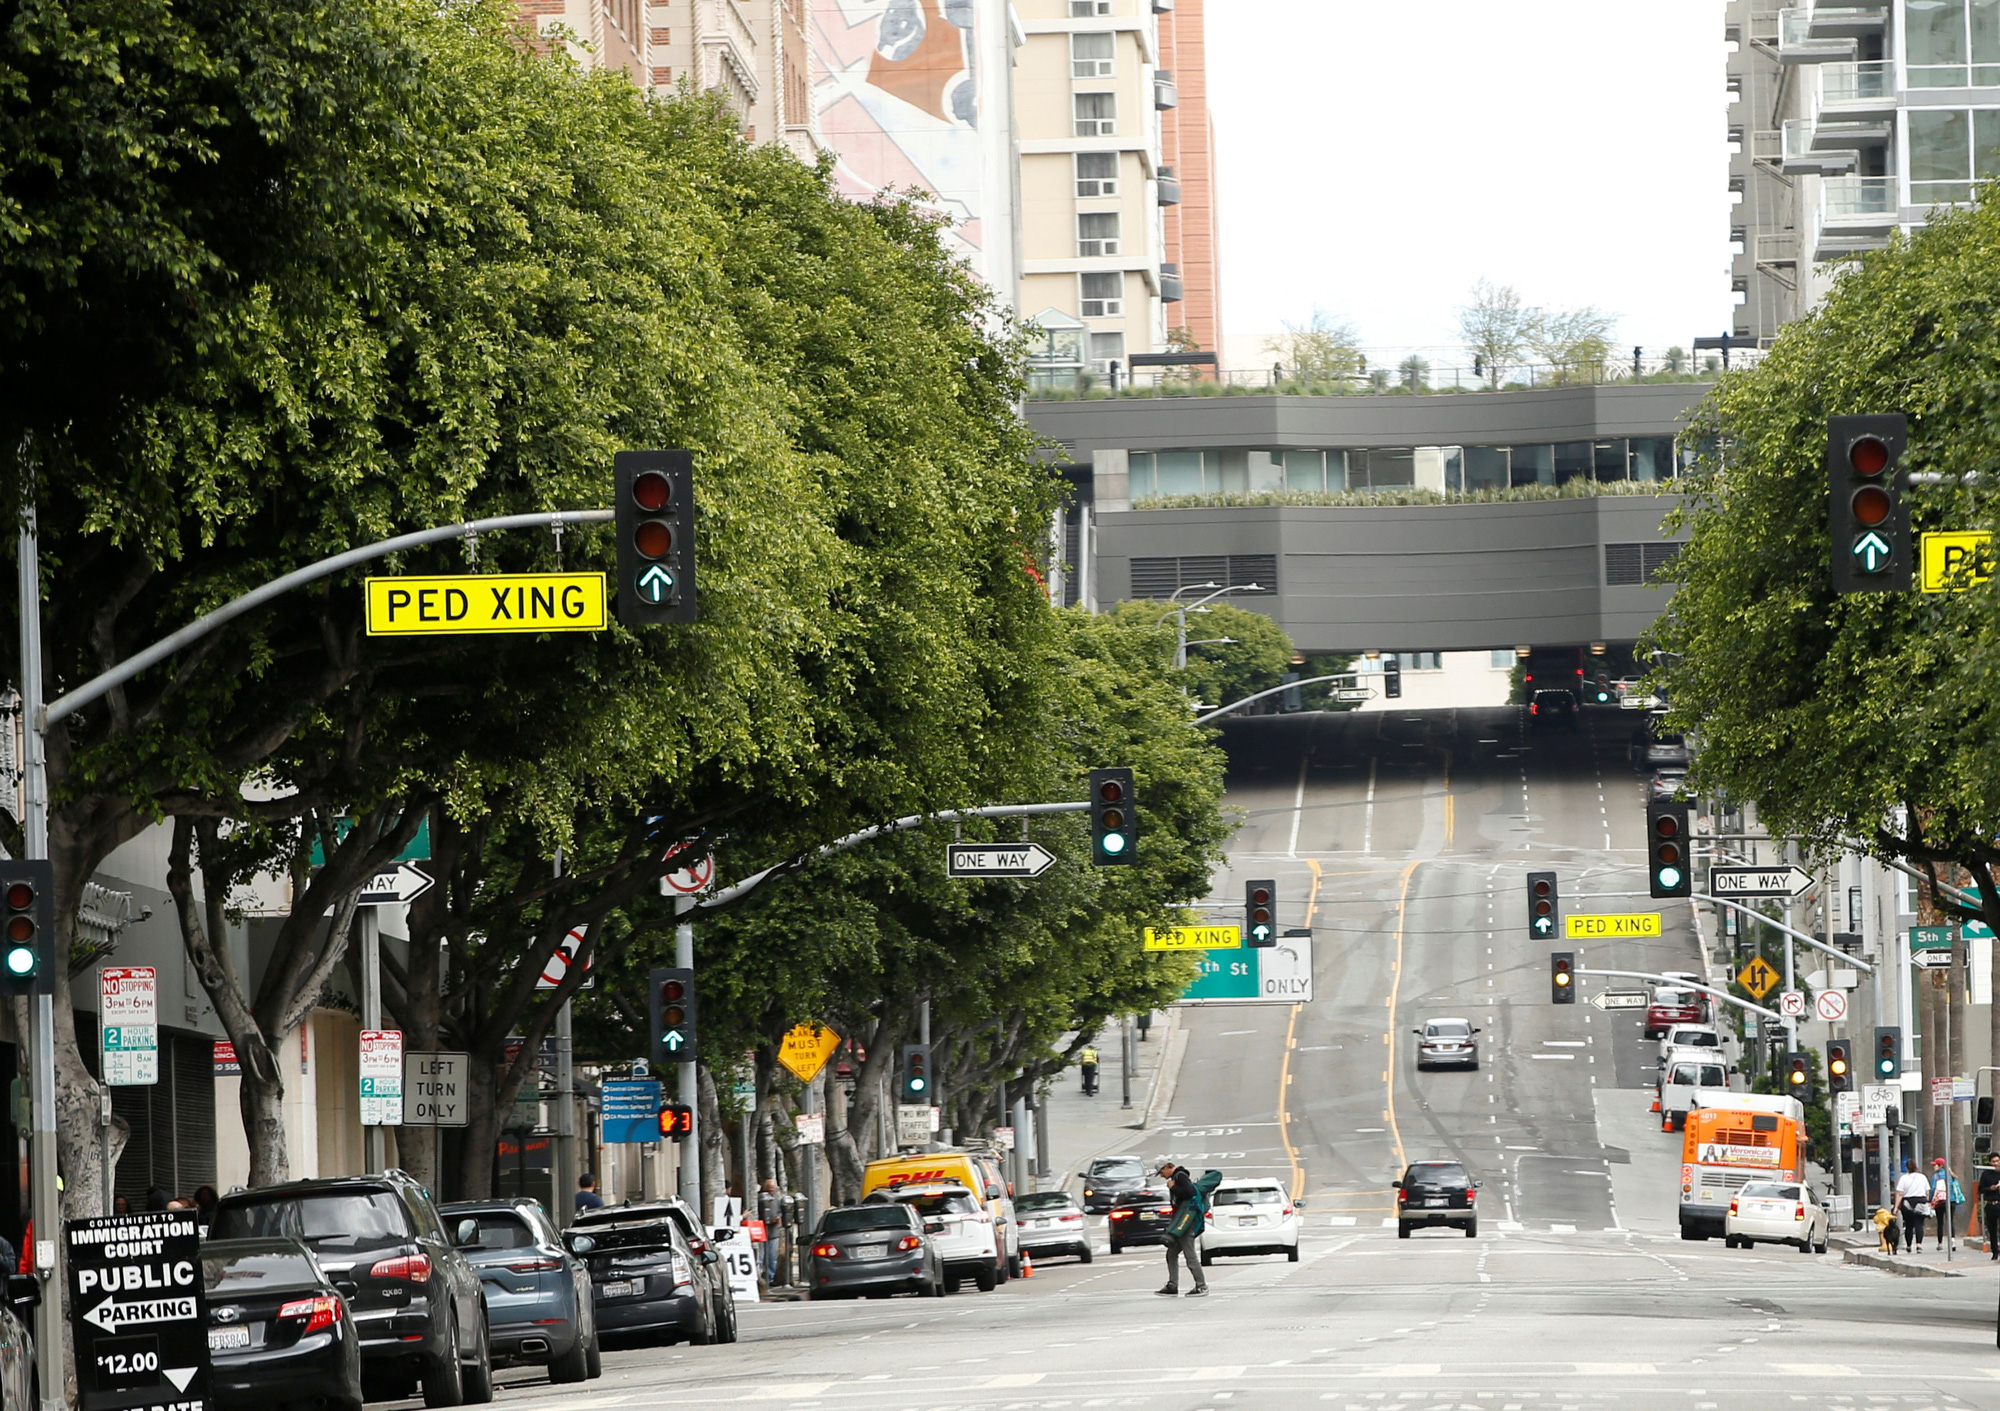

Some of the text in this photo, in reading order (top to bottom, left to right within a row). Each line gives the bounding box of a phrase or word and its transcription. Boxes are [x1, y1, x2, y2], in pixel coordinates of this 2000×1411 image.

[387, 585, 585, 622] PED XING
[956, 853, 1028, 868] ONE WAY
[1718, 874, 1789, 890] ONE WAY
[1574, 918, 1652, 933] PED XING
[1152, 930, 1232, 946] PED XING
[1917, 931, 1939, 942] 5th
[1927, 954, 1943, 962] ONE
[1229, 962, 1248, 976] St
[103, 979, 154, 994] NO STOPPING
[1265, 978, 1309, 994] ONLY
[105, 996, 125, 1009] 3PM
[133, 996, 153, 1009] 6PM
[107, 1027, 149, 1044] 2 HOUR
[123, 1035, 154, 1046] PARKING
[361, 1040, 400, 1052] NO STOPPING
[788, 1039, 821, 1050] MUST
[794, 1052, 817, 1060] TURN
[420, 1061, 455, 1075] LEFT
[797, 1063, 817, 1072] LEFT
[363, 1079, 372, 1091] 2
[376, 1085, 399, 1094] PARKING
[416, 1082, 456, 1096] TURN
[416, 1103, 456, 1117] ONLY
[899, 1110, 914, 1118] TWO
[901, 1121, 930, 1129] TRAFFIC
[902, 1132, 928, 1140] AHEAD
[1154, 1151, 1246, 1160] CLEAR
[1729, 1146, 1774, 1156] Veronica's
[89, 1213, 175, 1228] CONVENIENT TO
[71, 1221, 194, 1245] IMMIGRATION
[104, 1240, 164, 1259] COURT
[727, 1253, 753, 1276] 15
[78, 1260, 195, 1295] PUBLIC
[99, 1300, 193, 1323] PARKING
[97, 1352, 158, 1375] $12.00
